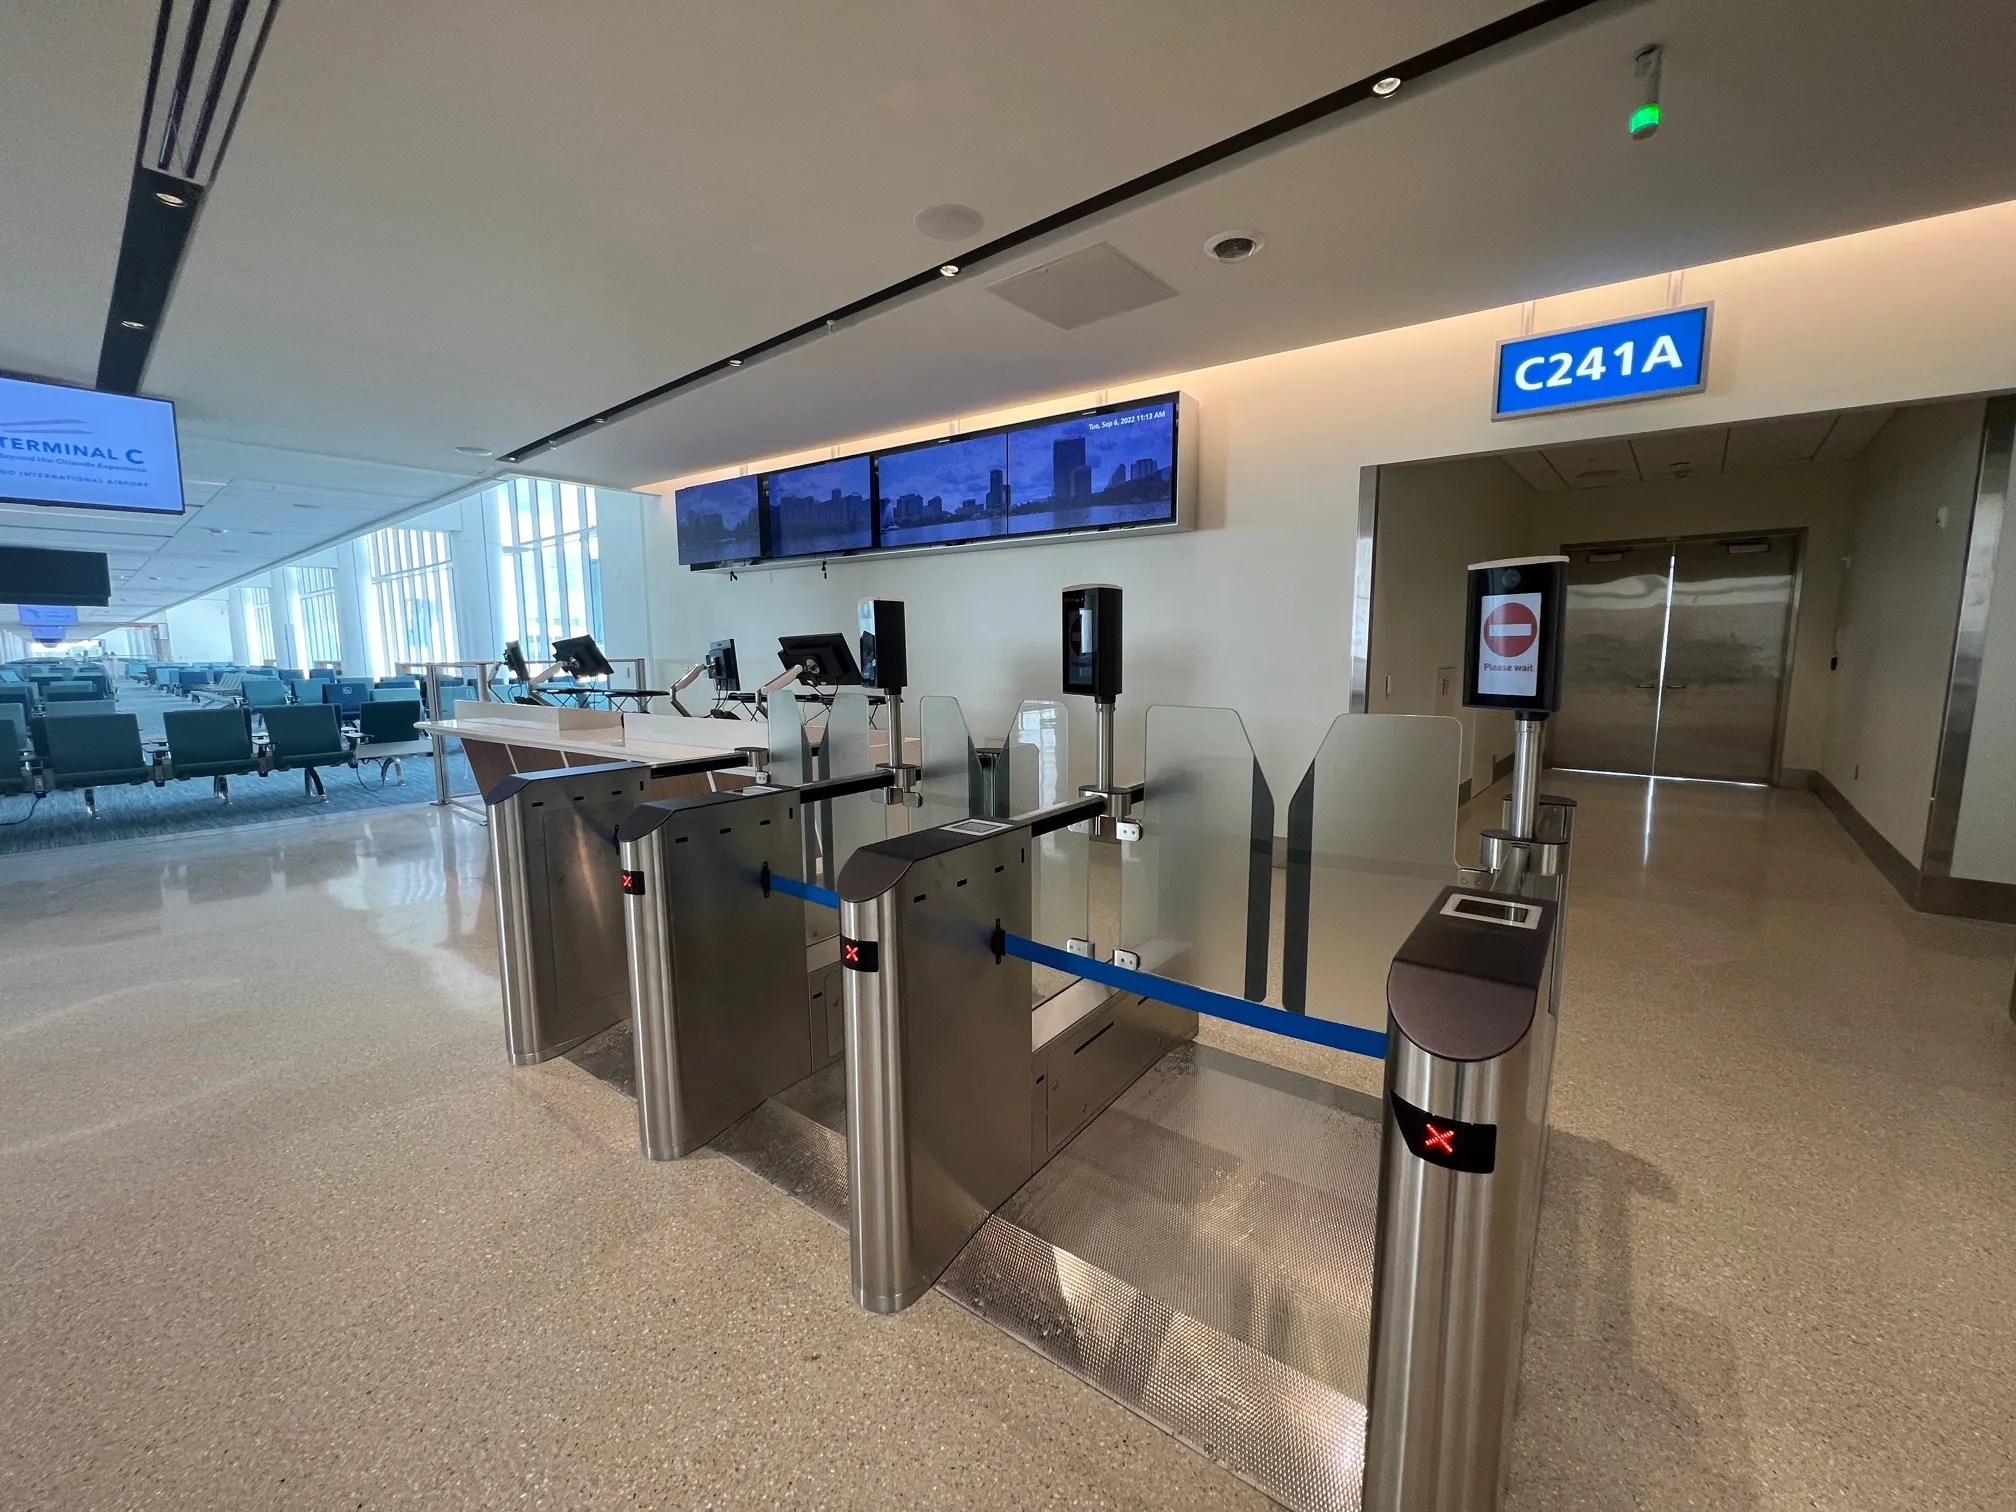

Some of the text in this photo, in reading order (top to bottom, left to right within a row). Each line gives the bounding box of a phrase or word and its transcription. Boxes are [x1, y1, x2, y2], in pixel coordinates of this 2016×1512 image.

[1515, 335, 1683, 391] C241A
[1121, 416, 1135, 425] 2022
[1136, 412, 1153, 422] 11:13
[1154, 410, 1166, 419] AM
[0, 436, 145, 465] TERMINAL C
[1483, 663, 1534, 672] Please wait
